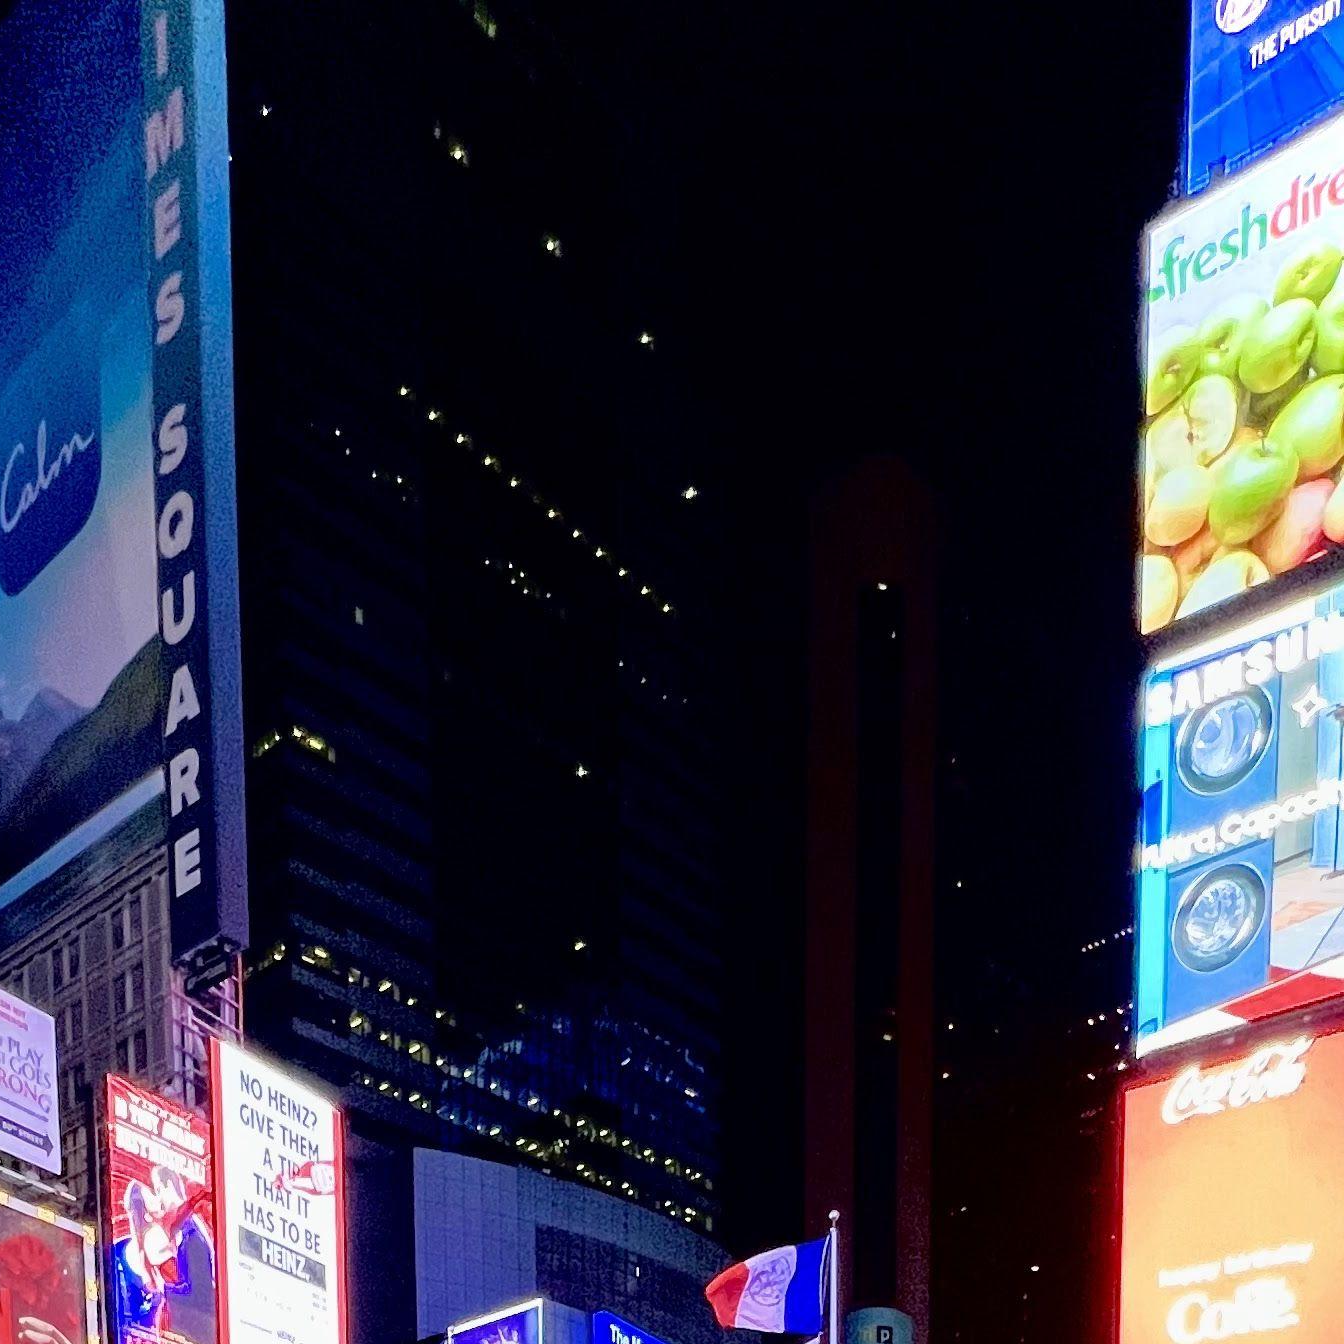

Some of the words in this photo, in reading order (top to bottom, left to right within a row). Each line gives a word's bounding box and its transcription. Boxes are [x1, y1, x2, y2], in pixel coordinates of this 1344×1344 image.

[1249, 33, 1278, 70] THE
[0, 419, 95, 533] Calm
[158, 403, 202, 898] SQUARE
[240, 1070, 262, 1101] NO
[268, 1086, 317, 1131] HEINZ?
[239, 1103, 274, 1140] GIVE
[279, 1124, 319, 1162] THEM
[263, 1147, 274, 1171] A
[253, 1172, 294, 1210] THAT
[297, 1194, 311, 1219] IT
[243, 1199, 275, 1234] HAS
[279, 1216, 299, 1245] TO
[304, 1229, 321, 1255] BE
